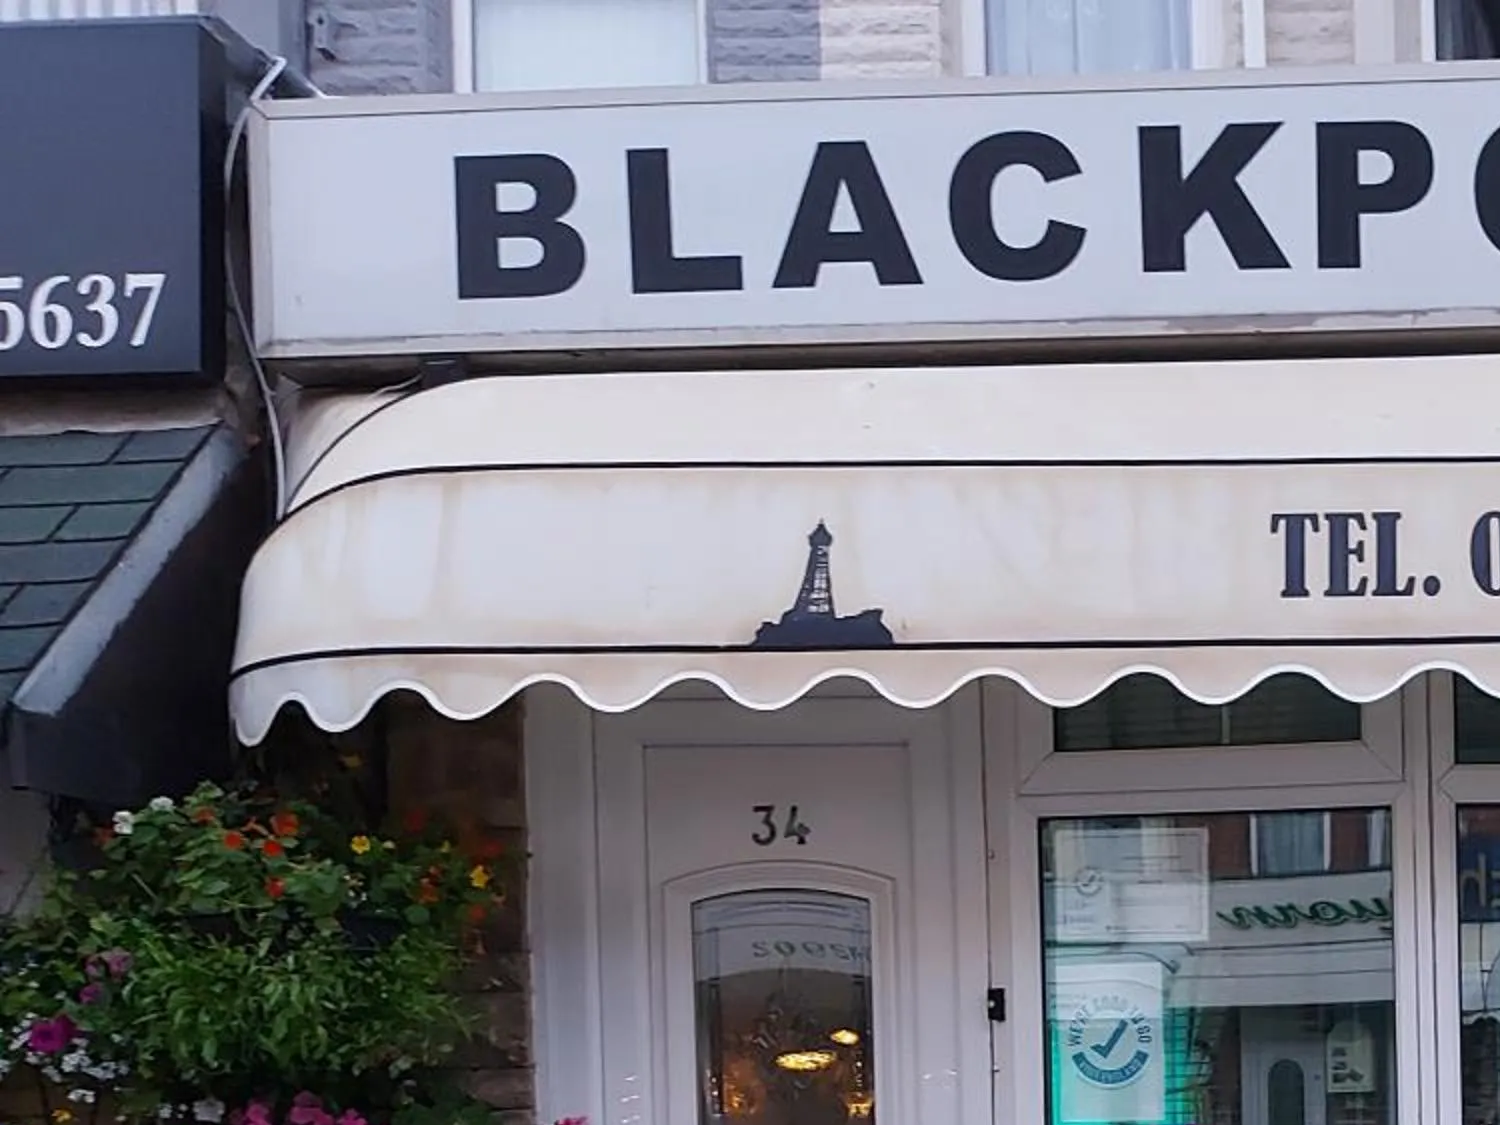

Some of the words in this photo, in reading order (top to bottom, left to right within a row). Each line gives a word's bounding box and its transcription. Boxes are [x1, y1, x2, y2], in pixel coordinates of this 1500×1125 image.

[0, 273, 167, 349] 5637
[1270, 511, 1441, 597] TEL.
[751, 804, 811, 846] 34
